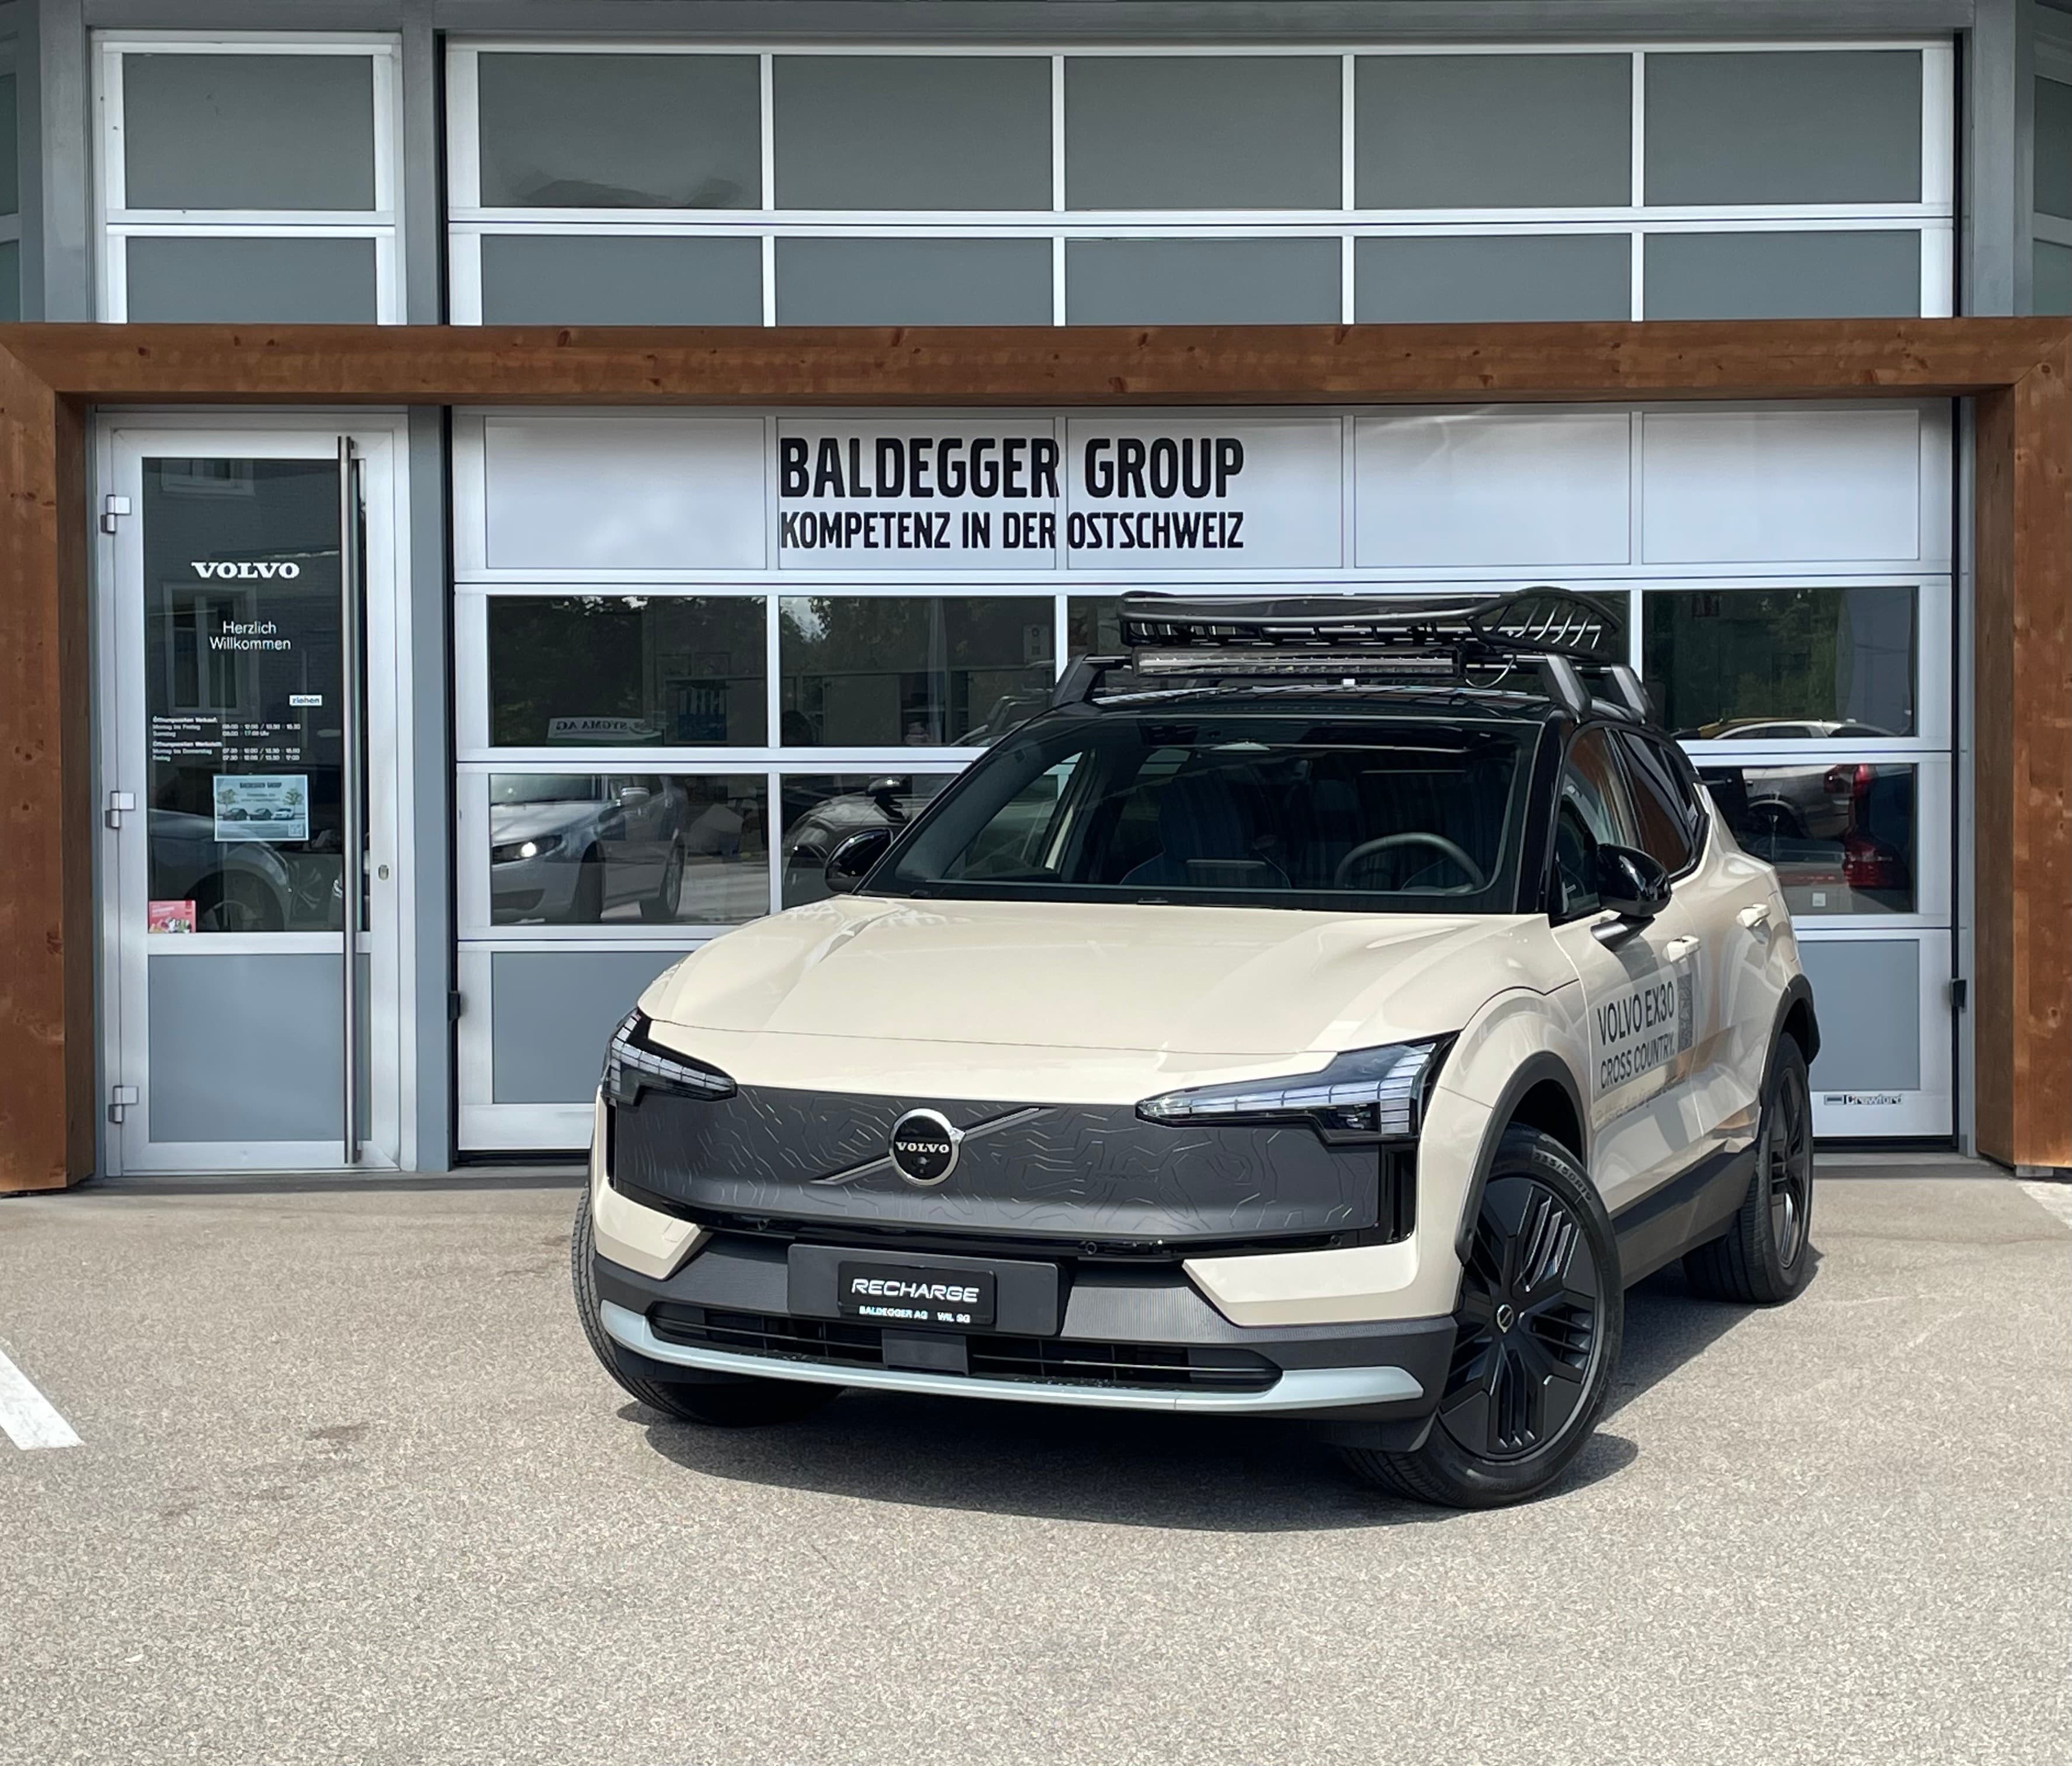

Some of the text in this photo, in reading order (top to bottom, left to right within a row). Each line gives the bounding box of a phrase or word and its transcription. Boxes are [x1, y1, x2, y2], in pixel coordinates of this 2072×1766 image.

[779, 437, 1244, 498] BALDEGGER GROUP
[780, 511, 1244, 549] KOMPETENZ IN DER OSTSCHWEIZ
[191, 562, 300, 579] VOLVO
[223, 621, 277, 635] Herzlich
[209, 637, 291, 651] Willkommen
[1598, 981, 1675, 1046] VOLVO EX30
[1600, 1049, 1632, 1089] CROSS
[896, 1141, 950, 1154] VOLVO
[851, 1278, 980, 1303] RECHARGE
[859, 1305, 912, 1319] BALDEGGER
[914, 1309, 929, 1319] AG
